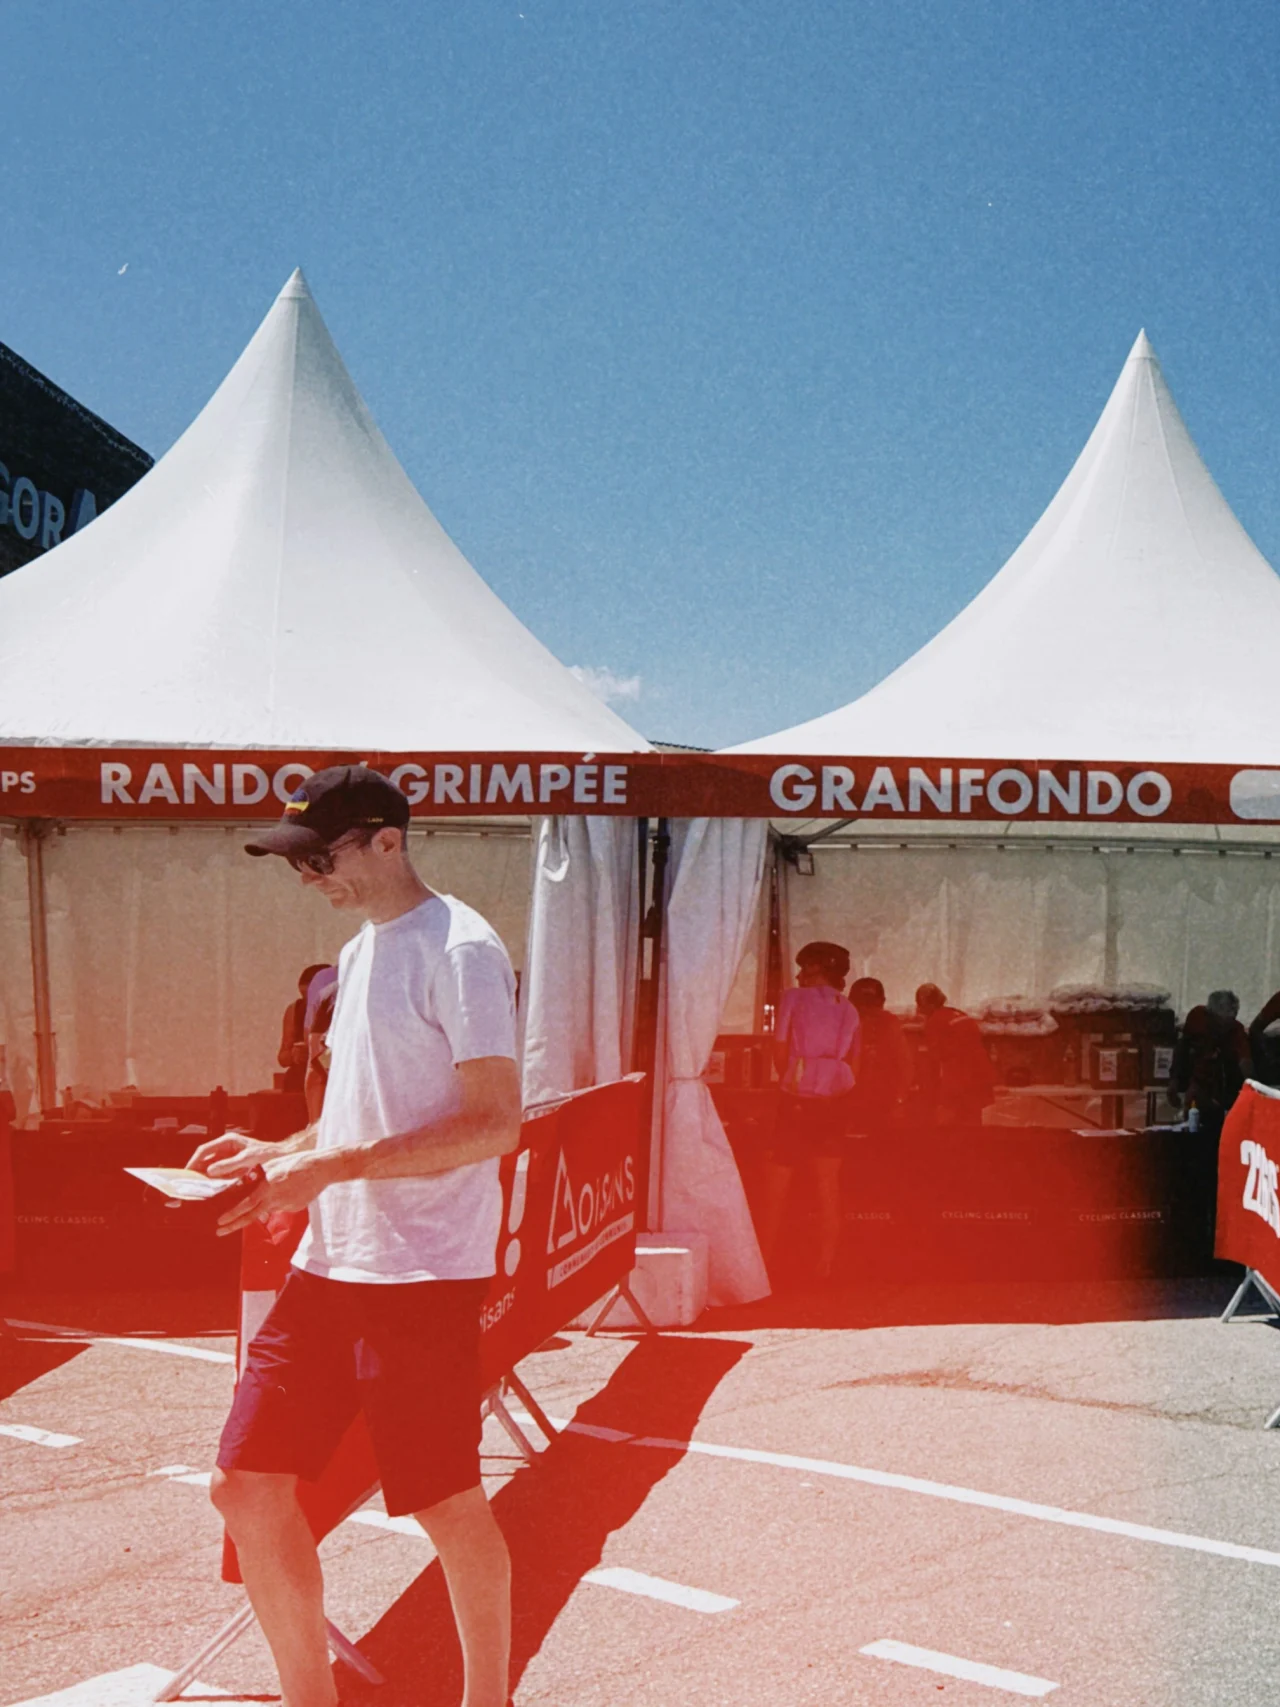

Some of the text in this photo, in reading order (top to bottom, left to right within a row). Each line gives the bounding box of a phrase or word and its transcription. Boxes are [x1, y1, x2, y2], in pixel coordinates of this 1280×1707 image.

[99, 752, 628, 805] RANDO GRIMPÉE
[769, 763, 1173, 817] GRANFONDO
